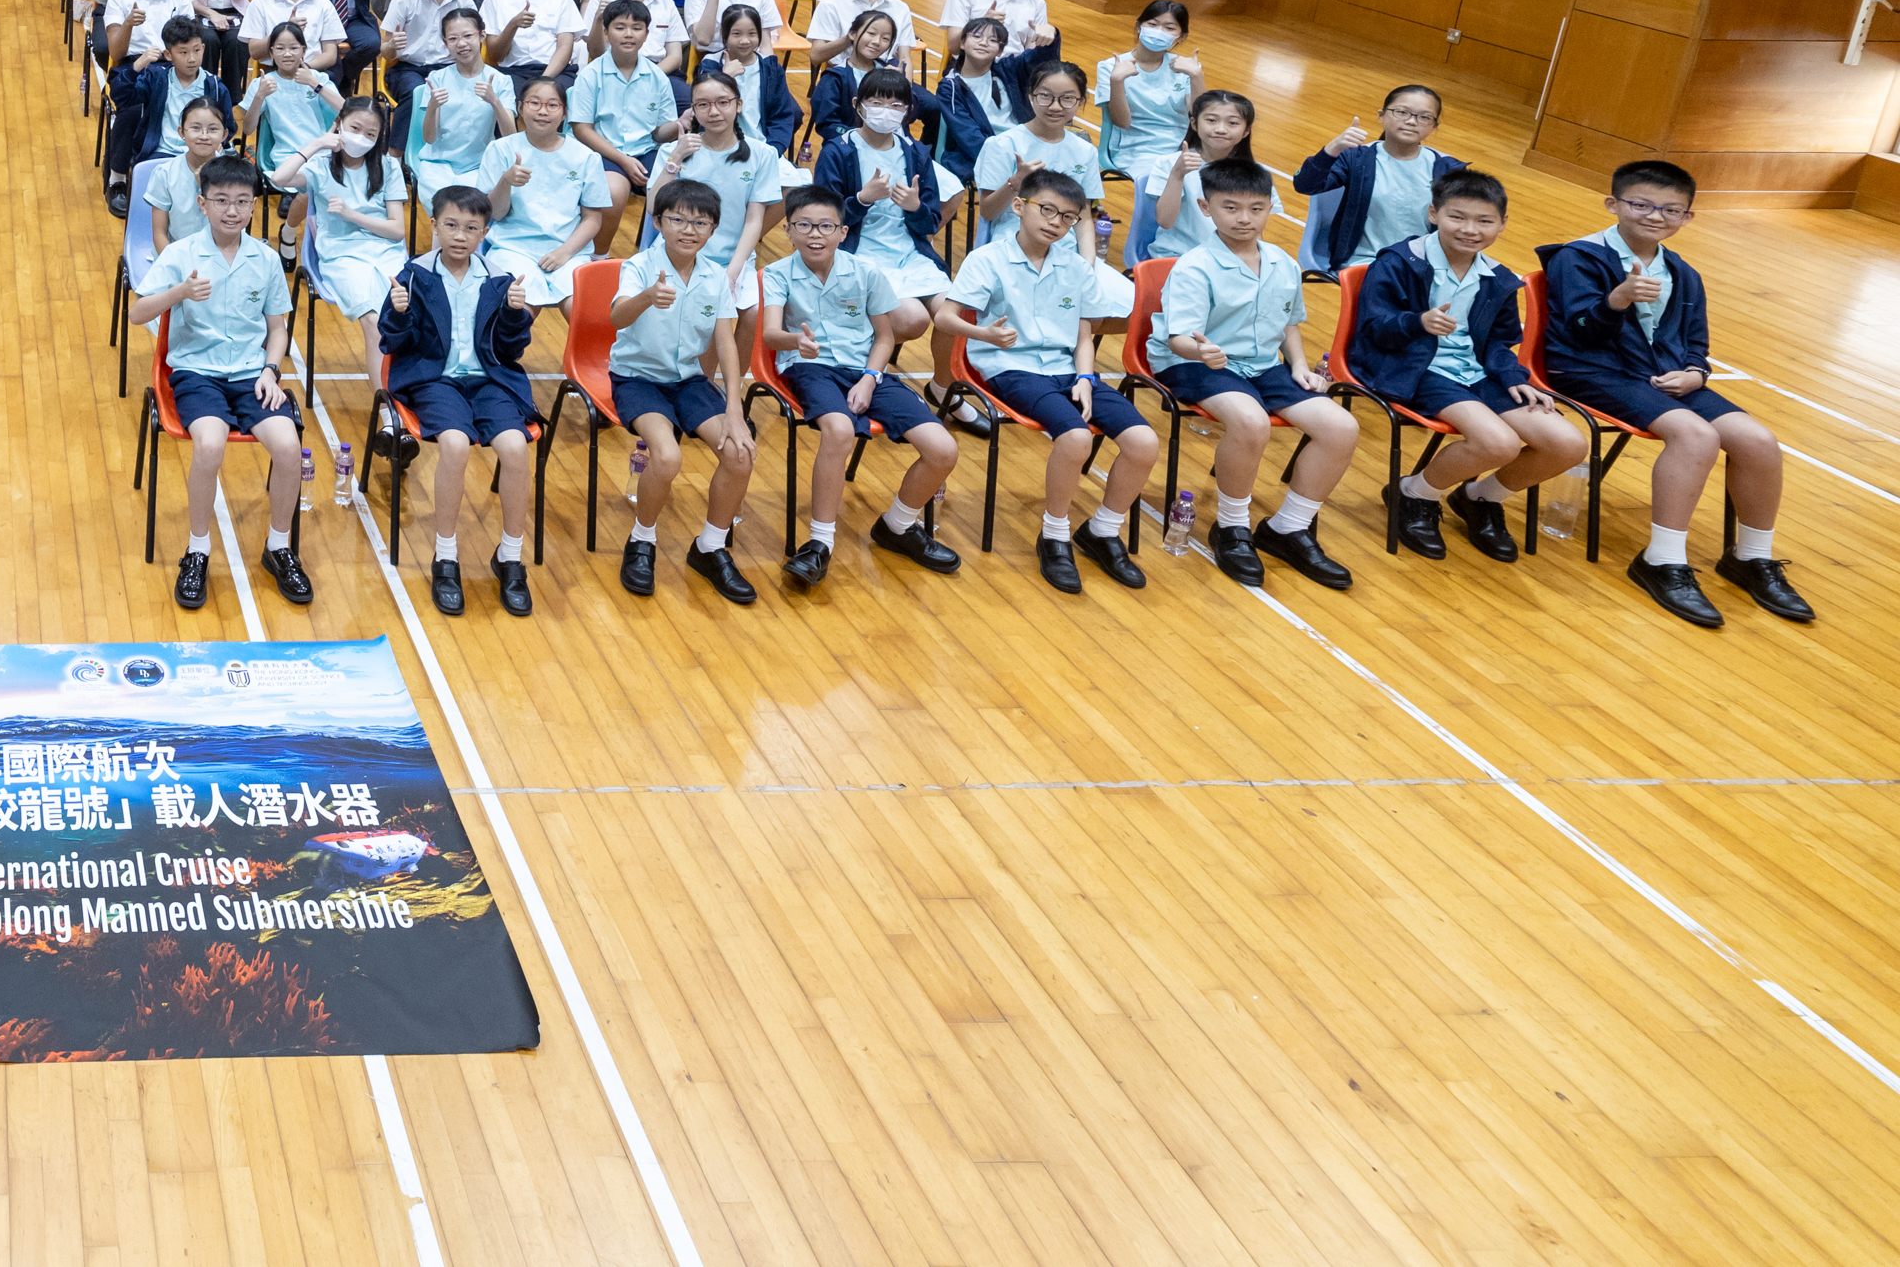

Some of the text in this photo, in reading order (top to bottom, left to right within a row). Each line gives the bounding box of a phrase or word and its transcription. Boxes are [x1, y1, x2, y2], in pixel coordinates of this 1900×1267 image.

[154, 849, 252, 886] Cruise
[80, 892, 208, 933] Manned
[212, 889, 414, 932] Submersible
